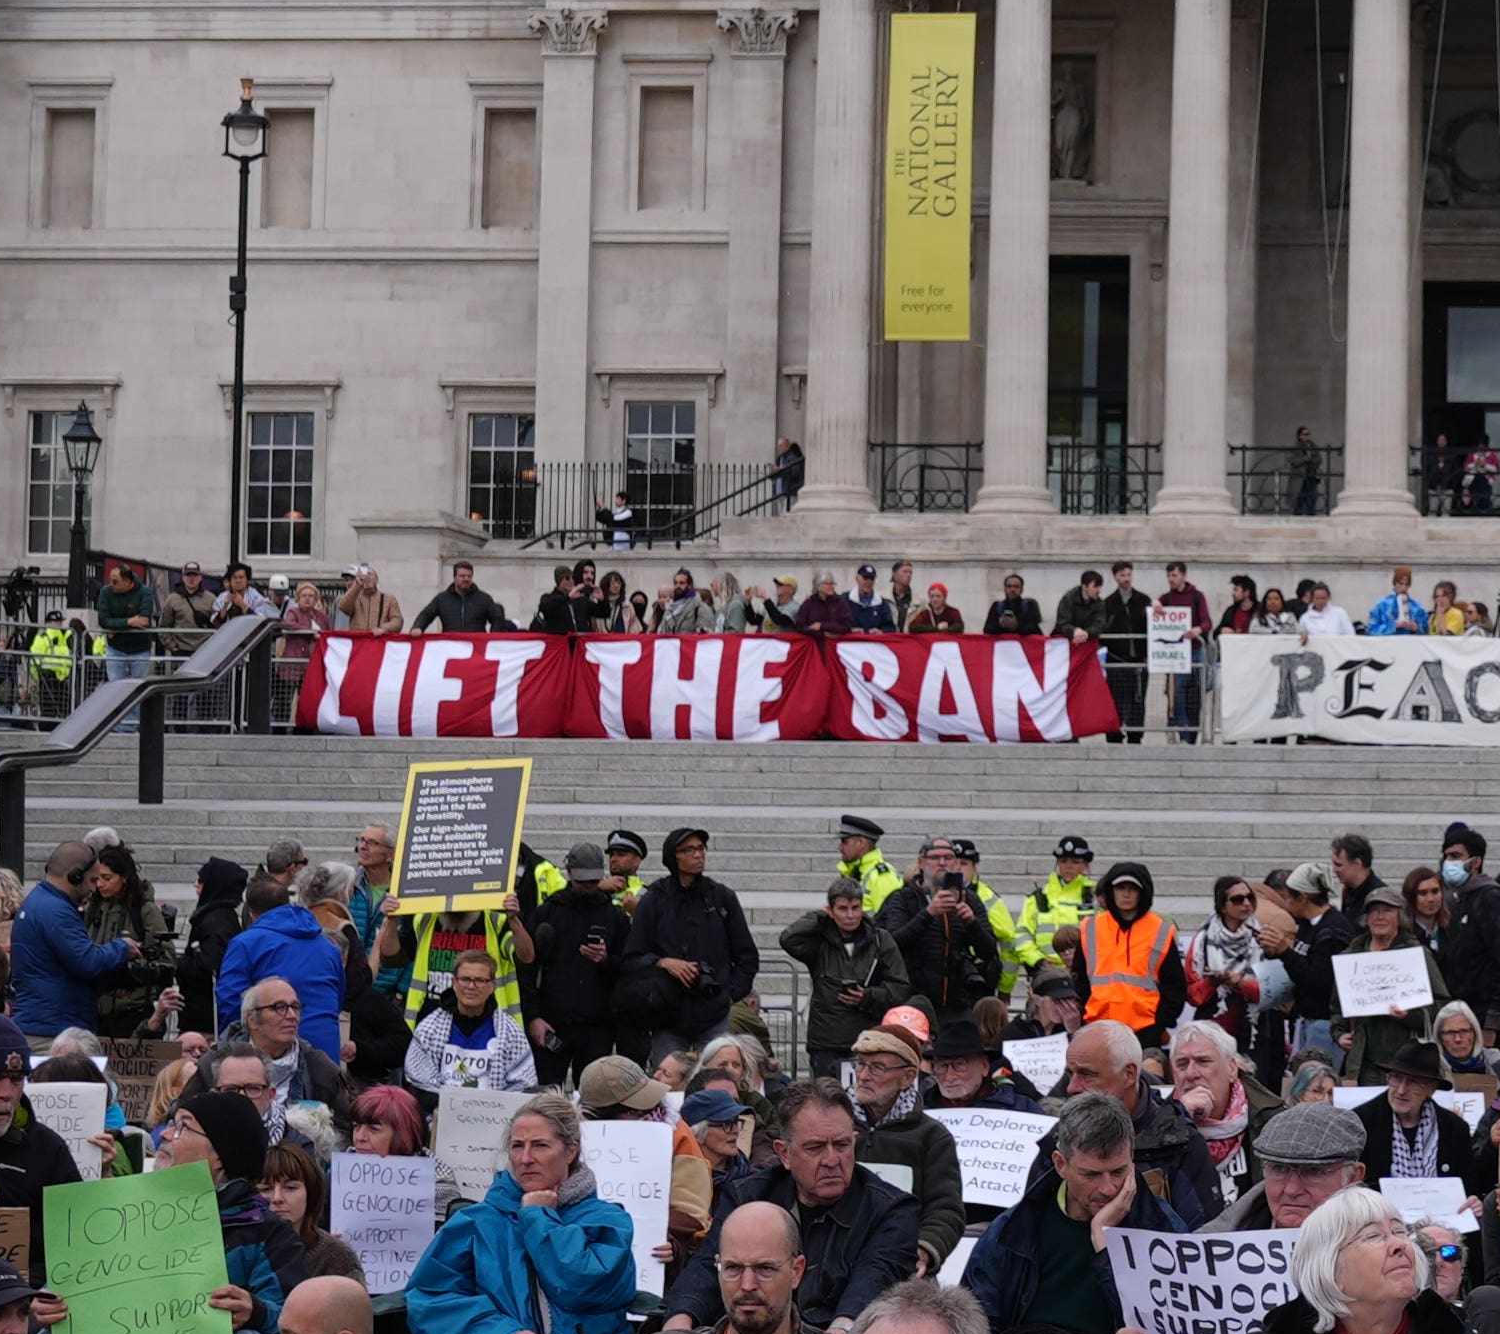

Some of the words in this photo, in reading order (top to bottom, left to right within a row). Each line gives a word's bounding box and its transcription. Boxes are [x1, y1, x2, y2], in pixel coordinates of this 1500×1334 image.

[908, 66, 932, 216] NATIONAL
[932, 68, 959, 217] GALLERY
[895, 148, 905, 177] THE
[901, 284, 926, 297] Free
[929, 284, 944, 297] for
[901, 302, 953, 315] everyone
[1152, 611, 1187, 623] STOP
[1152, 624, 1187, 632] ARMING
[1152, 651, 1187, 661] ISRAEL
[316, 635, 546, 738] LIFT
[584, 638, 791, 742] THE
[836, 638, 1072, 743] BAN
[422, 779, 438, 787] The
[440, 777, 493, 786] atmosphere
[431, 787, 467, 795] stillness
[469, 785, 493, 793] holds
[419, 796, 444, 805] space
[426, 812, 465, 821] hostility.
[414, 826, 430, 834] Our
[432, 823, 487, 833] sign-holders
[412, 835, 428, 843] ask
[430, 834, 443, 842] for
[444, 832, 486, 841] solidarity
[411, 842, 476, 851] demonstrators
[410, 851, 426, 861] join
[428, 851, 452, 859] them
[464, 849, 479, 857] the
[480, 848, 504, 857] quiet
[409, 861, 441, 869] solemn
[443, 859, 472, 867] nature
[485, 857, 502, 865] this
[407, 869, 451, 880] particular
[453, 867, 483, 876] action.
[970, 1115, 1044, 1134] Deplores
[954, 1136, 1024, 1152] Genocide
[965, 1177, 1020, 1195] Attack
